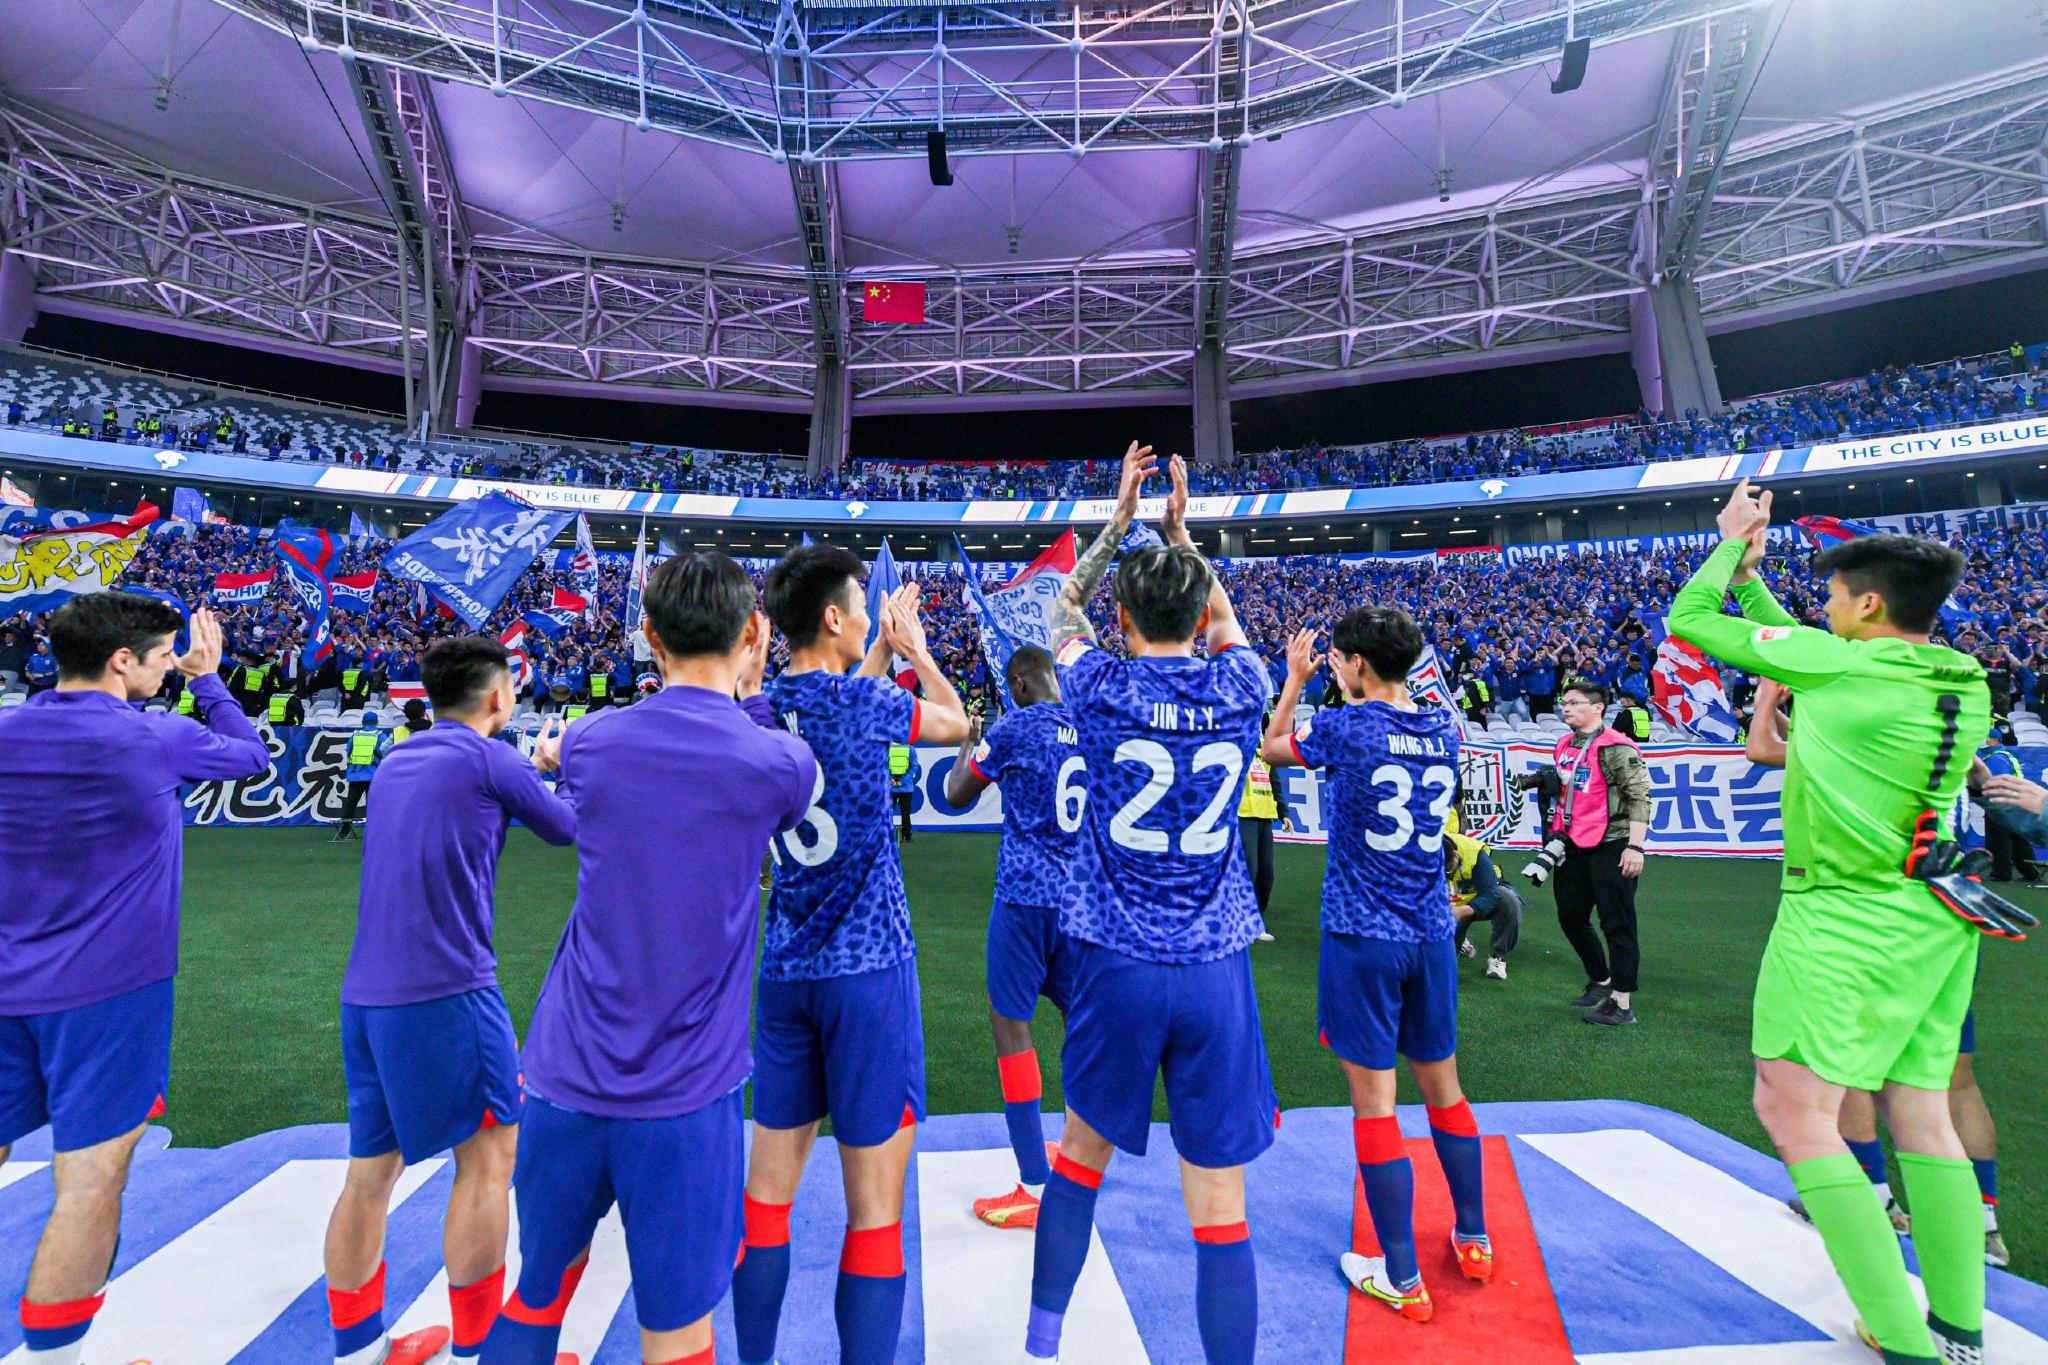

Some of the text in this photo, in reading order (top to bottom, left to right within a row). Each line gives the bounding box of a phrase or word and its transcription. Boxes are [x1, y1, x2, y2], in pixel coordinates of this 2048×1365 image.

[1838, 425, 2048, 460] THE CITY IS BLUE
[546, 490, 558, 501] IS
[564, 491, 601, 504] BLUE
[1507, 544, 1569, 569] ONCE
[1652, 532, 1721, 553] ALWA
[1150, 702, 1221, 731] JIN Y.Y.
[1386, 733, 1423, 755] WANG
[1926, 694, 1962, 790] 1
[1055, 756, 1088, 833] 6
[1109, 738, 1244, 855] 22
[1364, 764, 1456, 853] 33
